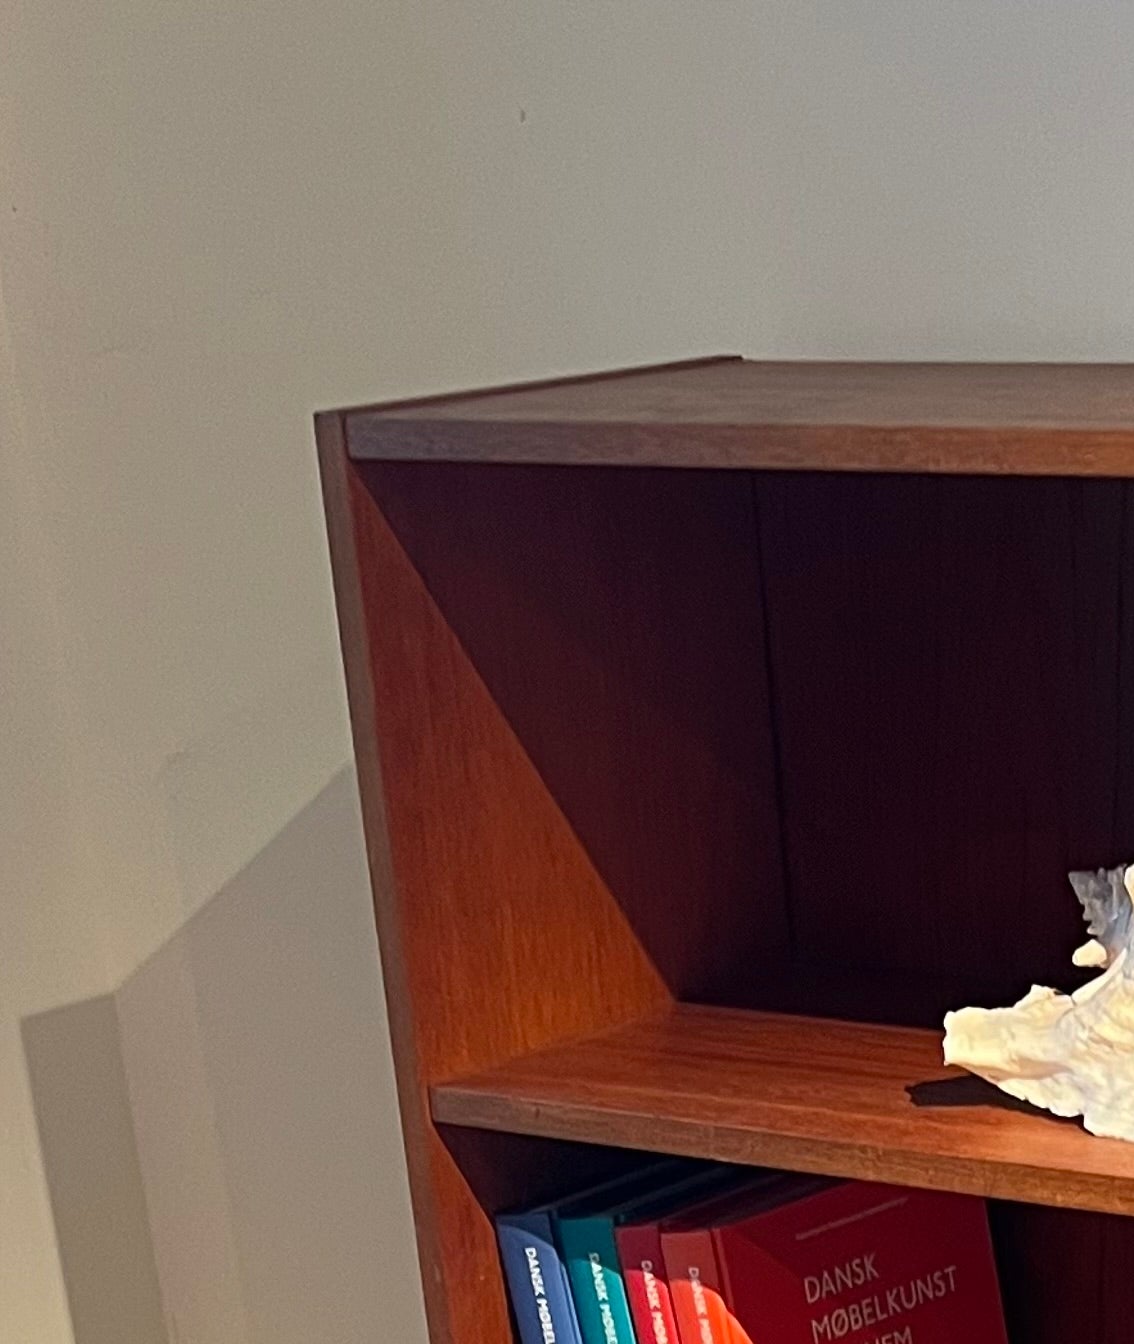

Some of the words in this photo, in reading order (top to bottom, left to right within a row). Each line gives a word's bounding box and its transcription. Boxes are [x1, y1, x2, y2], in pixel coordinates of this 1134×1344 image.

[524, 1247, 545, 1297] DANSK
[589, 1253, 608, 1302] DANSK
[641, 1260, 660, 1311] DANSK
[688, 1267, 707, 1315] DANSK
[803, 1253, 879, 1304] DANSK
[811, 1265, 957, 1344] MØBELKUNST
